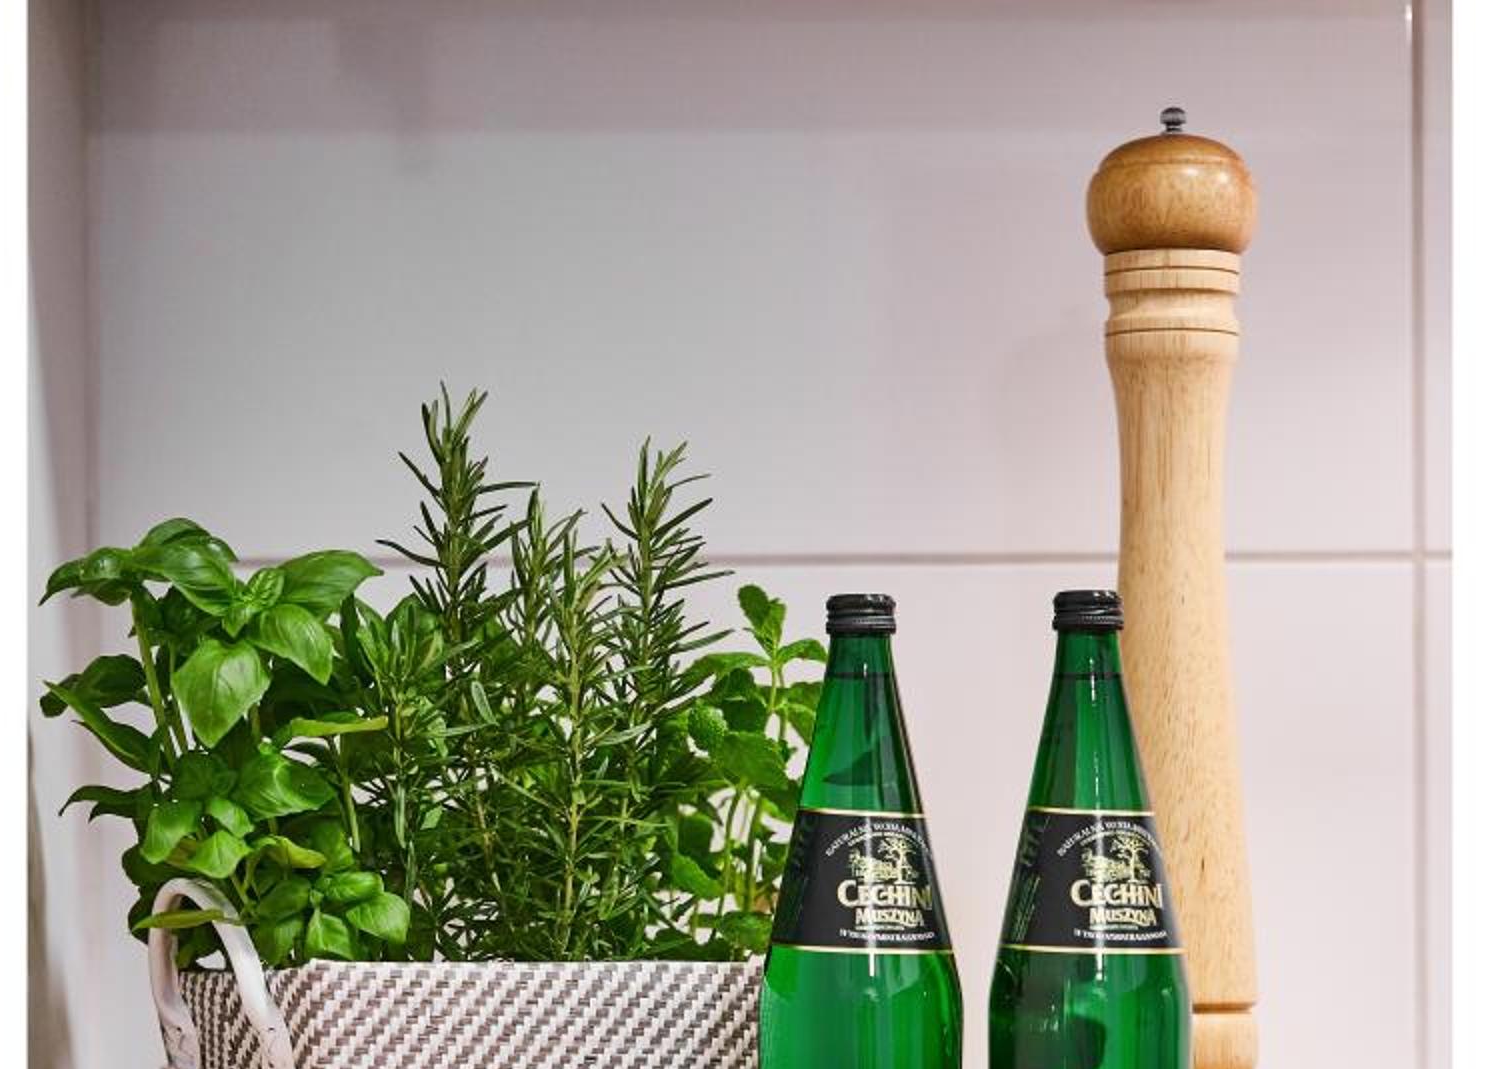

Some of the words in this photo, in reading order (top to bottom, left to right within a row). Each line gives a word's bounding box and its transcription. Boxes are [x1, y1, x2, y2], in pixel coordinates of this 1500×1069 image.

[1070, 879, 1164, 909] CECHINI
[855, 907, 924, 927] MUSZYNA
[1089, 906, 1157, 927] MUSZYNA
